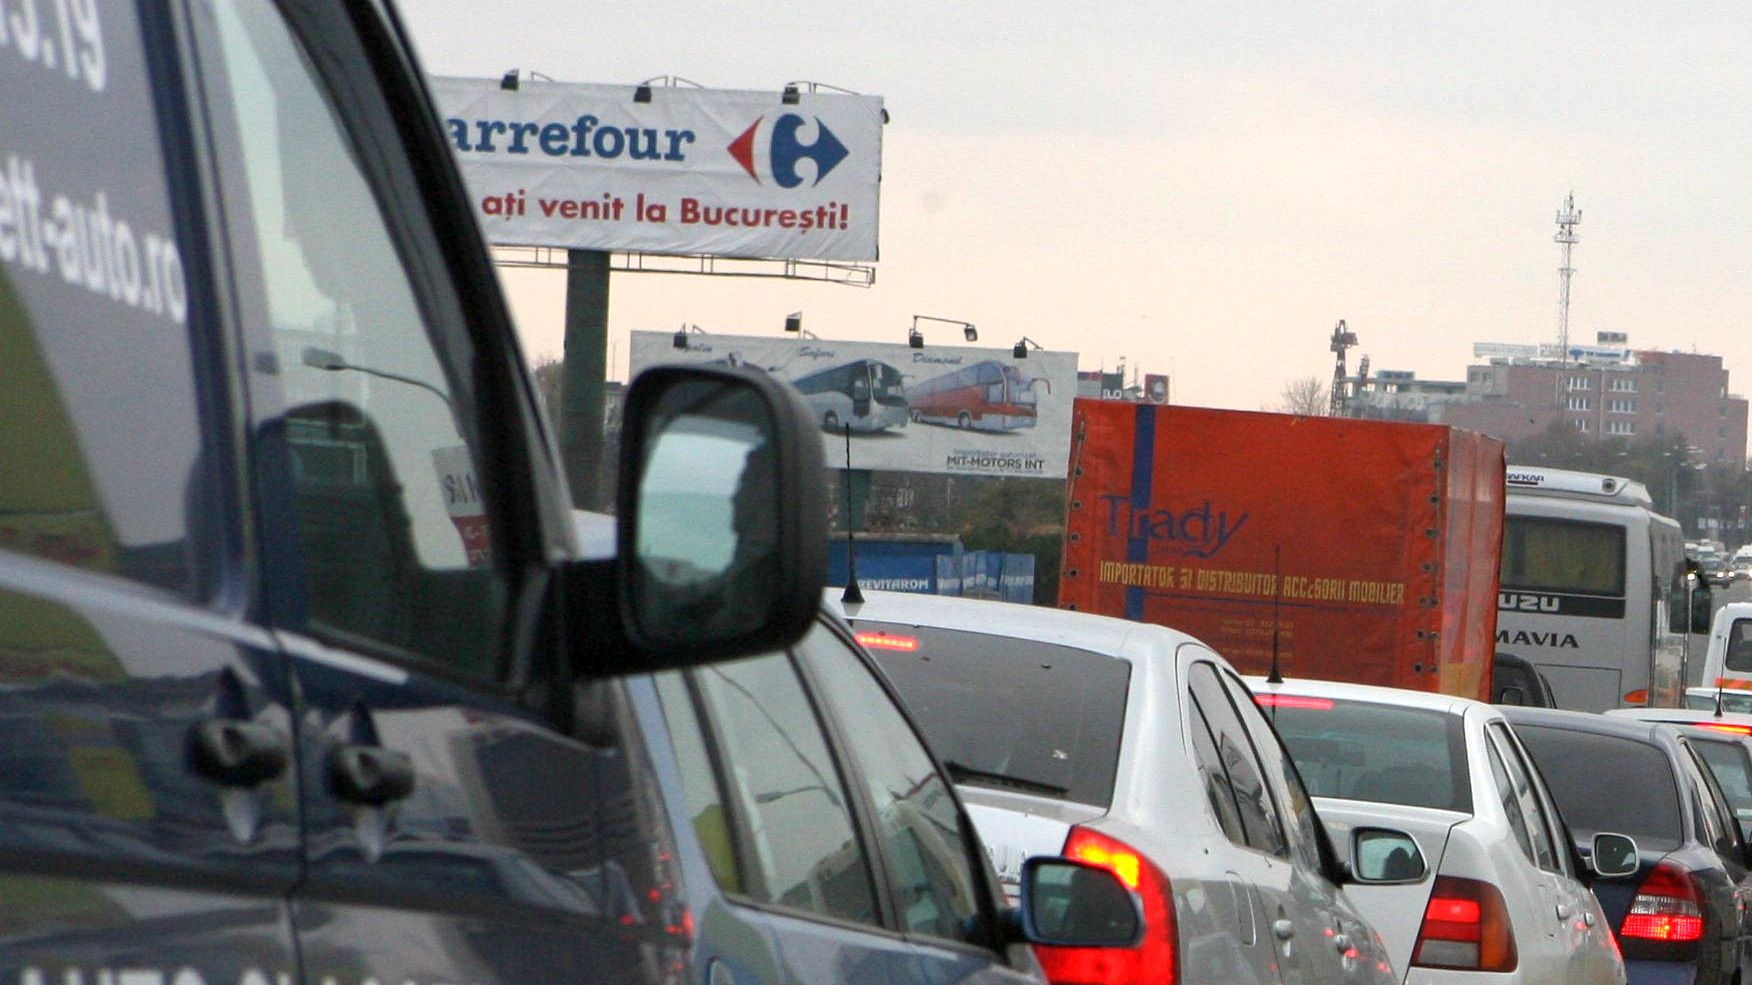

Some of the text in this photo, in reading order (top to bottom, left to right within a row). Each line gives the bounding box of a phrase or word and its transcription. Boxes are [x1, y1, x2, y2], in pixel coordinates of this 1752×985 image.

[446, 114, 695, 162] arrefour
[538, 192, 624, 222] venit
[636, 193, 667, 224] la
[946, 455, 1046, 470] MIT-MOTORS INT
[1099, 559, 1176, 589] IMPORTATOR
[1349, 579, 1405, 605] MOBILIER
[1498, 593, 1560, 612] UZU
